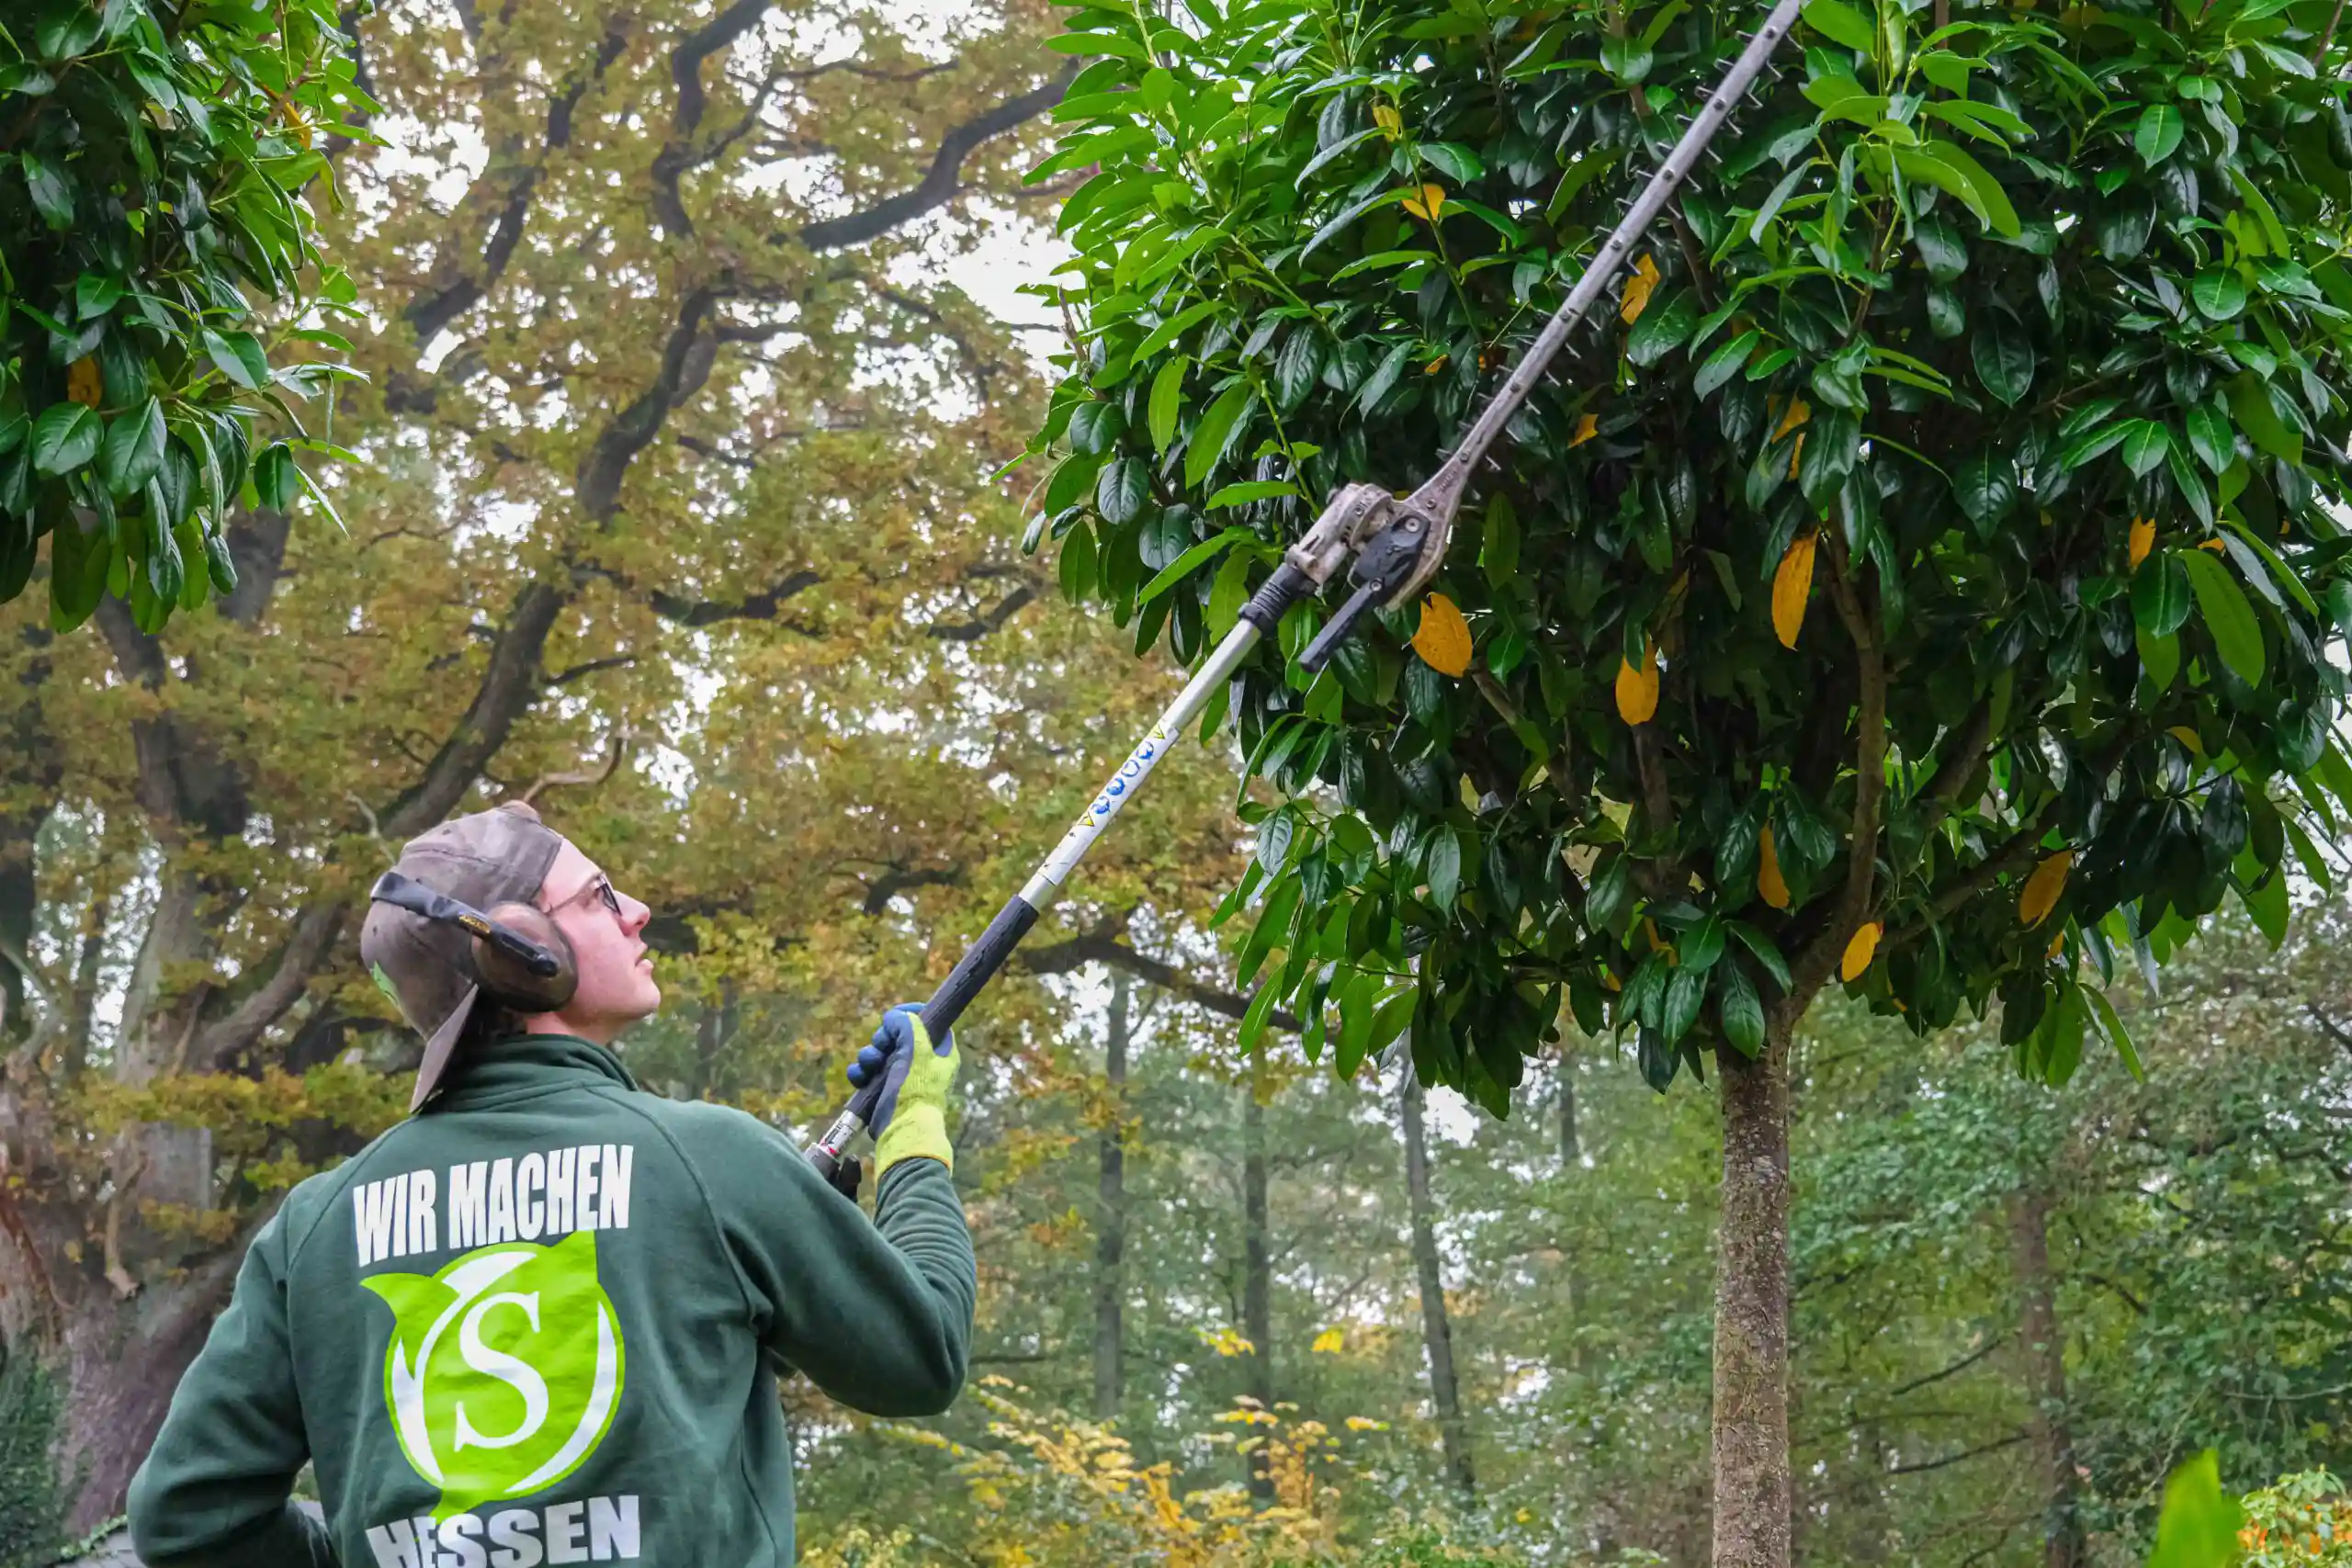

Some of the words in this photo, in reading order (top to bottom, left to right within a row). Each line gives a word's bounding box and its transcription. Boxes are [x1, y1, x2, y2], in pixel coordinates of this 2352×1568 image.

[353, 1168, 437, 1268] WIR
[447, 1145, 634, 1250] MACHEN
[453, 1291, 549, 1452] S
[366, 1495, 640, 1568] HESSEN
